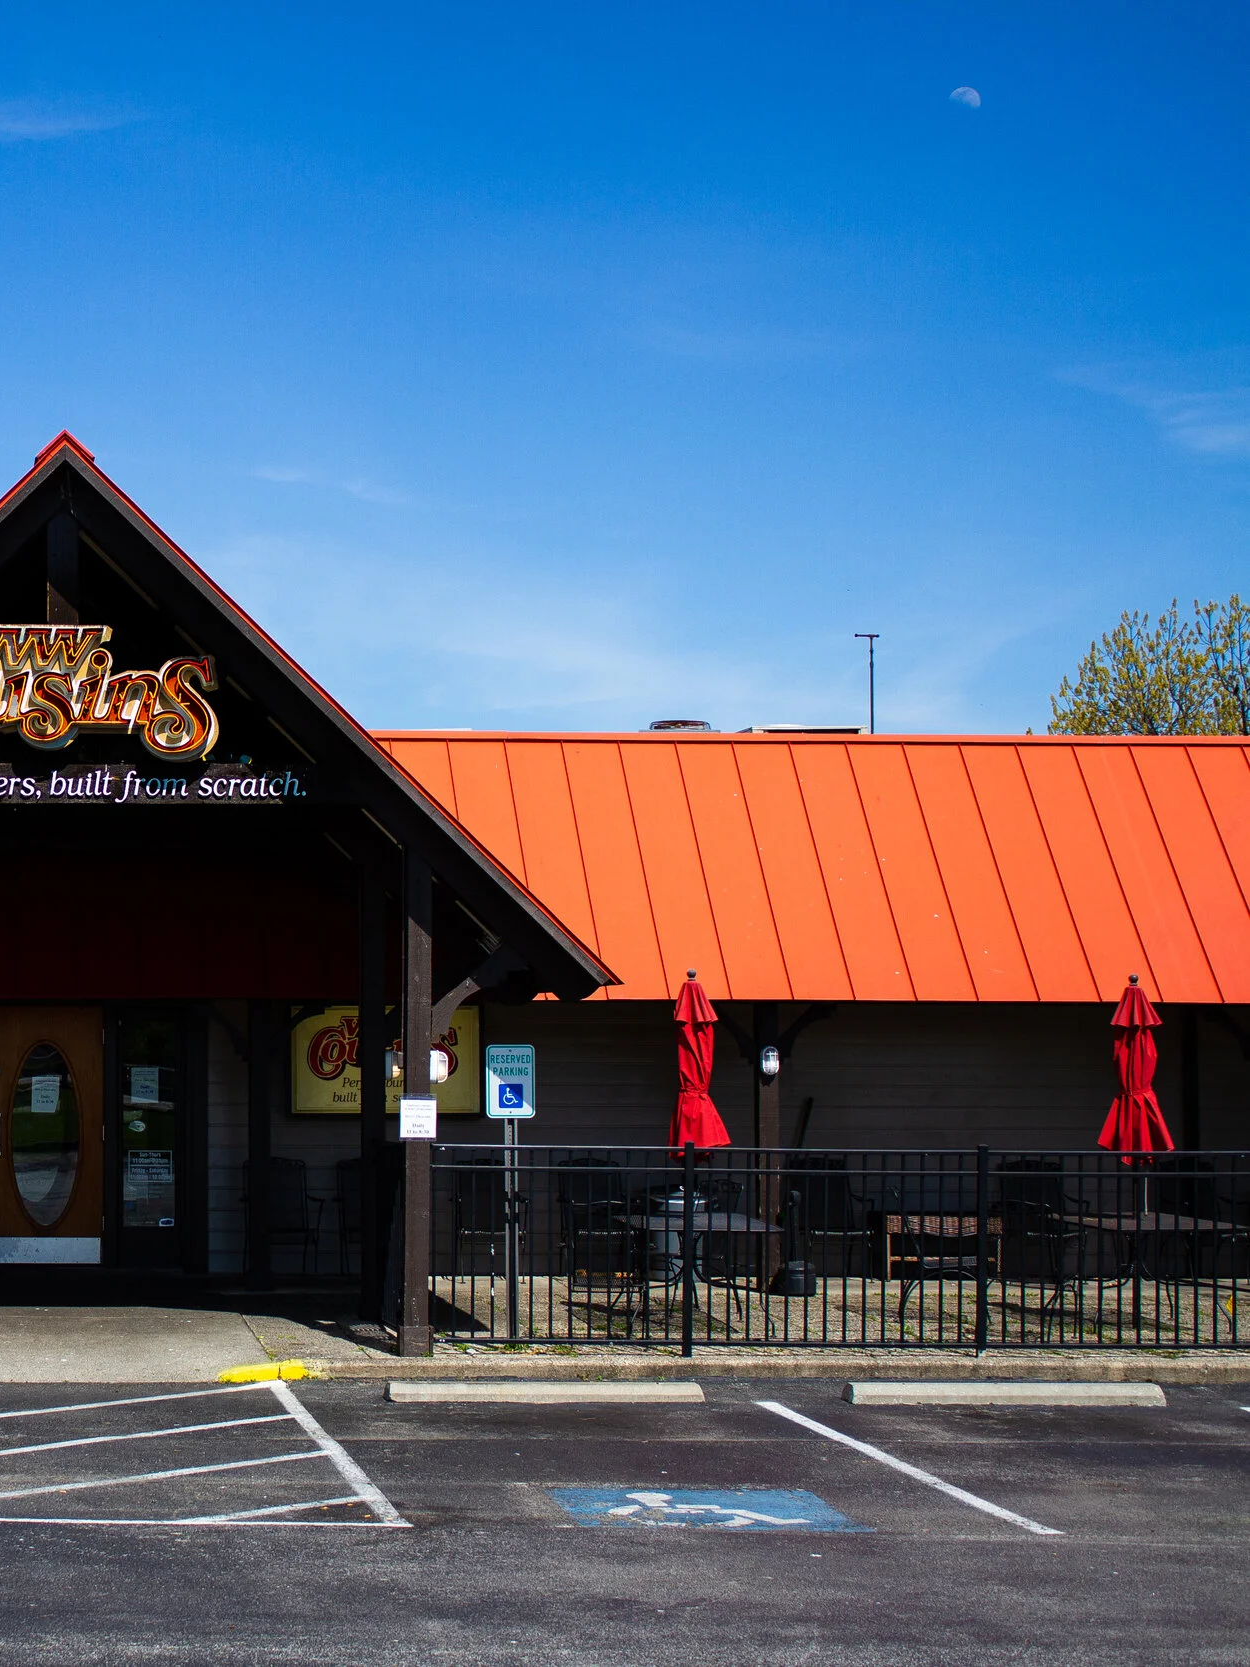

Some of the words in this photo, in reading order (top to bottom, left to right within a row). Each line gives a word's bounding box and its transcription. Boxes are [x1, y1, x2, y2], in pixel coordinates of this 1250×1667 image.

[49, 768, 114, 798] built
[117, 769, 188, 804] from
[197, 768, 308, 798] scratch.
[490, 1054, 532, 1064] RESERVED
[492, 1067, 529, 1076] PARKING
[332, 1092, 358, 1103] built
